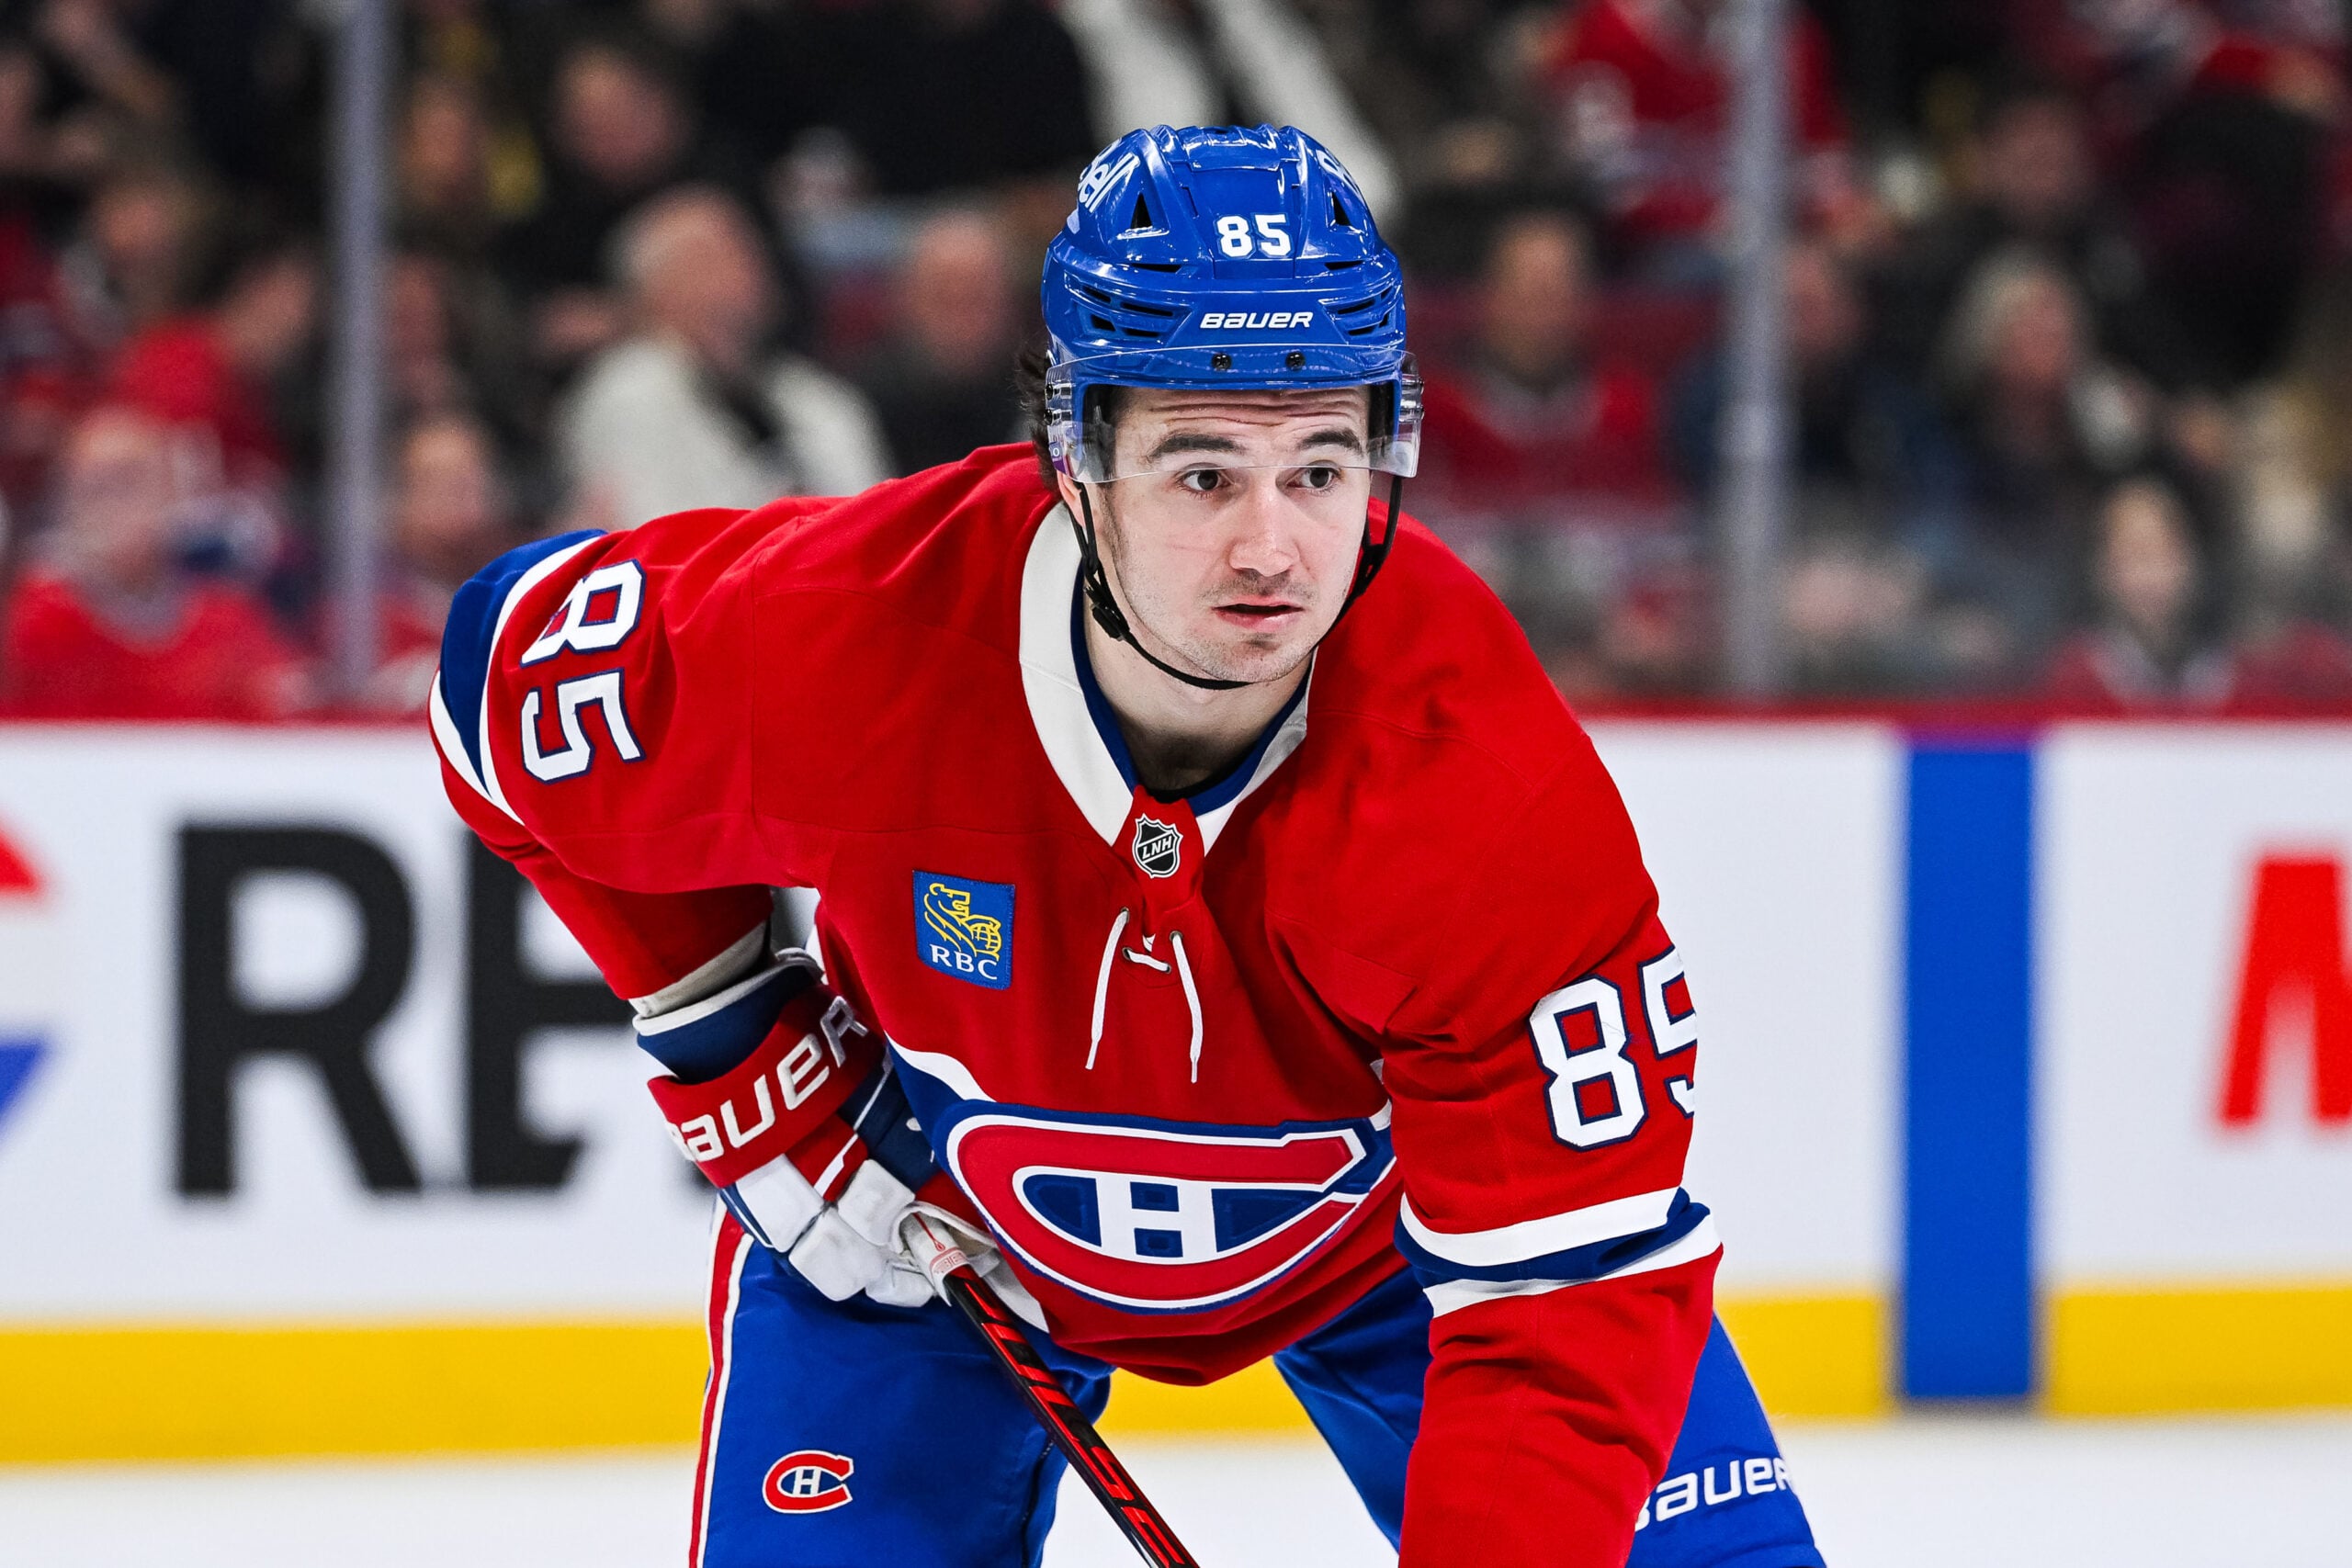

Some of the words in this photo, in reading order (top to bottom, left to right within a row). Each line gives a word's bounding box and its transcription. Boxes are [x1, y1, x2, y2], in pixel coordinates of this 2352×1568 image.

[1216, 214, 1292, 258] 85
[519, 558, 646, 785] 85
[1142, 835, 1172, 860] LNH
[175, 824, 717, 1197] RE
[930, 943, 998, 980] RBC
[1526, 944, 1698, 1153] 85
